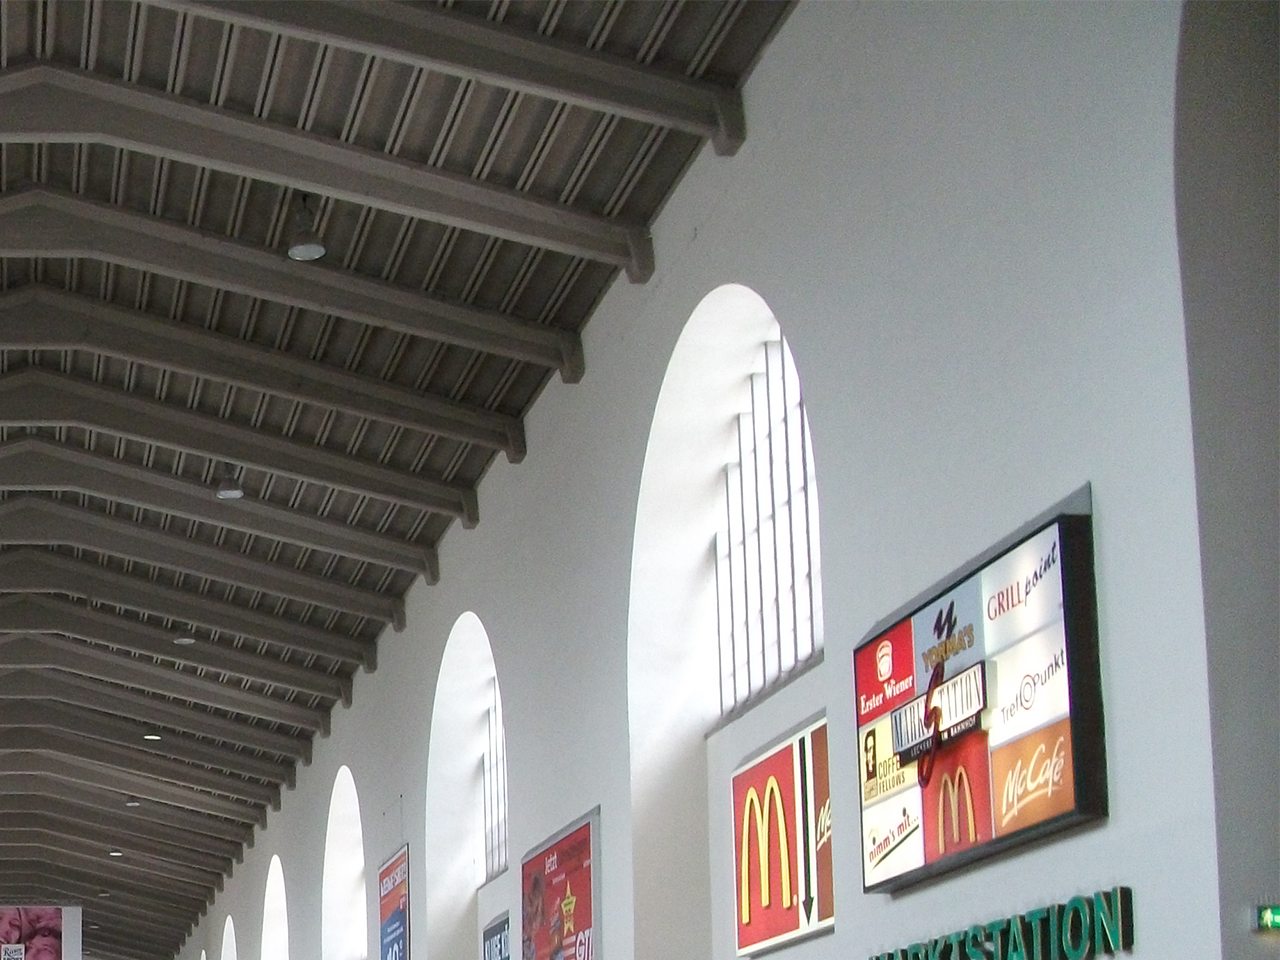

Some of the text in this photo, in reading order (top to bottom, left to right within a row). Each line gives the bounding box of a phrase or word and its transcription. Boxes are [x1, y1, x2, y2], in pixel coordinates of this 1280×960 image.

[923, 623, 974, 672] YORMA'S
[860, 674, 913, 715] Erster Wiener
[878, 756, 901, 780] COFFE
[879, 771, 905, 794] FELLOWS
[1002, 737, 1064, 818] McCafé
[544, 851, 558, 875] Jetzt
[869, 827, 896, 863] nimm's
